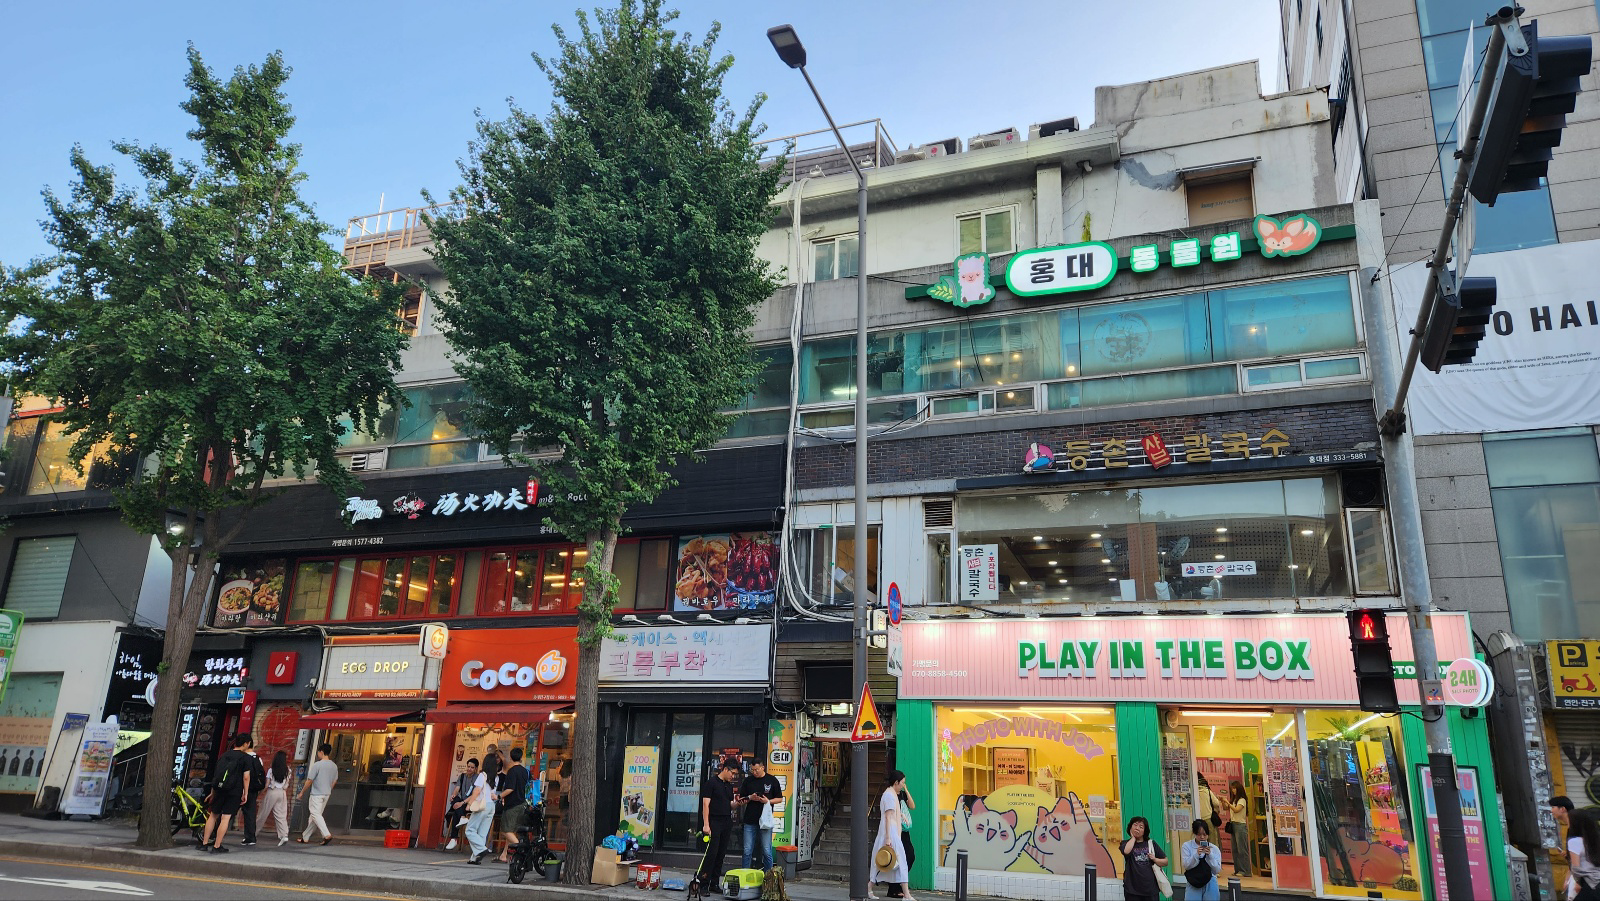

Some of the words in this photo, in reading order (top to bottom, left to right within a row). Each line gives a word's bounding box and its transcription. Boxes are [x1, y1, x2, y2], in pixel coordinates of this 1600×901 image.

[1029, 252, 1094, 284] 홍대
[1132, 231, 1240, 271] 동물원
[1065, 437, 1129, 471] 등촌
[1144, 433, 1170, 469] 샤브
[1183, 428, 1290, 464] 칼국수
[1309, 455, 1330, 463] 홍대점
[1333, 452, 1367, 461] 333-5881
[432, 487, 528, 516] 汤火功夫
[912, 659, 939, 668] 가맹문의
[1018, 640, 1100, 678] PLAY
[1108, 640, 1147, 678] IN
[1155, 638, 1227, 678] THE
[1234, 639, 1315, 680] BOX
[341, 662, 367, 674] EGG
[373, 661, 409, 673] DROP
[1449, 669, 1478, 687] 24H
[950, 717, 1013, 758] PHOTO
[1012, 716, 1063, 743] WITH
[1061, 730, 1105, 761] JOY
[634, 755, 650, 764] ZOO
[676, 750, 696, 763] 상가
[773, 752, 789, 762] 홍대
[637, 766, 652, 774] THE
[675, 763, 696, 775] 임대
[632, 775, 648, 784] CITY
[675, 776, 695, 787] 문의
[1091, 807, 1103, 815] 30
[1177, 820, 1189, 829] 30
